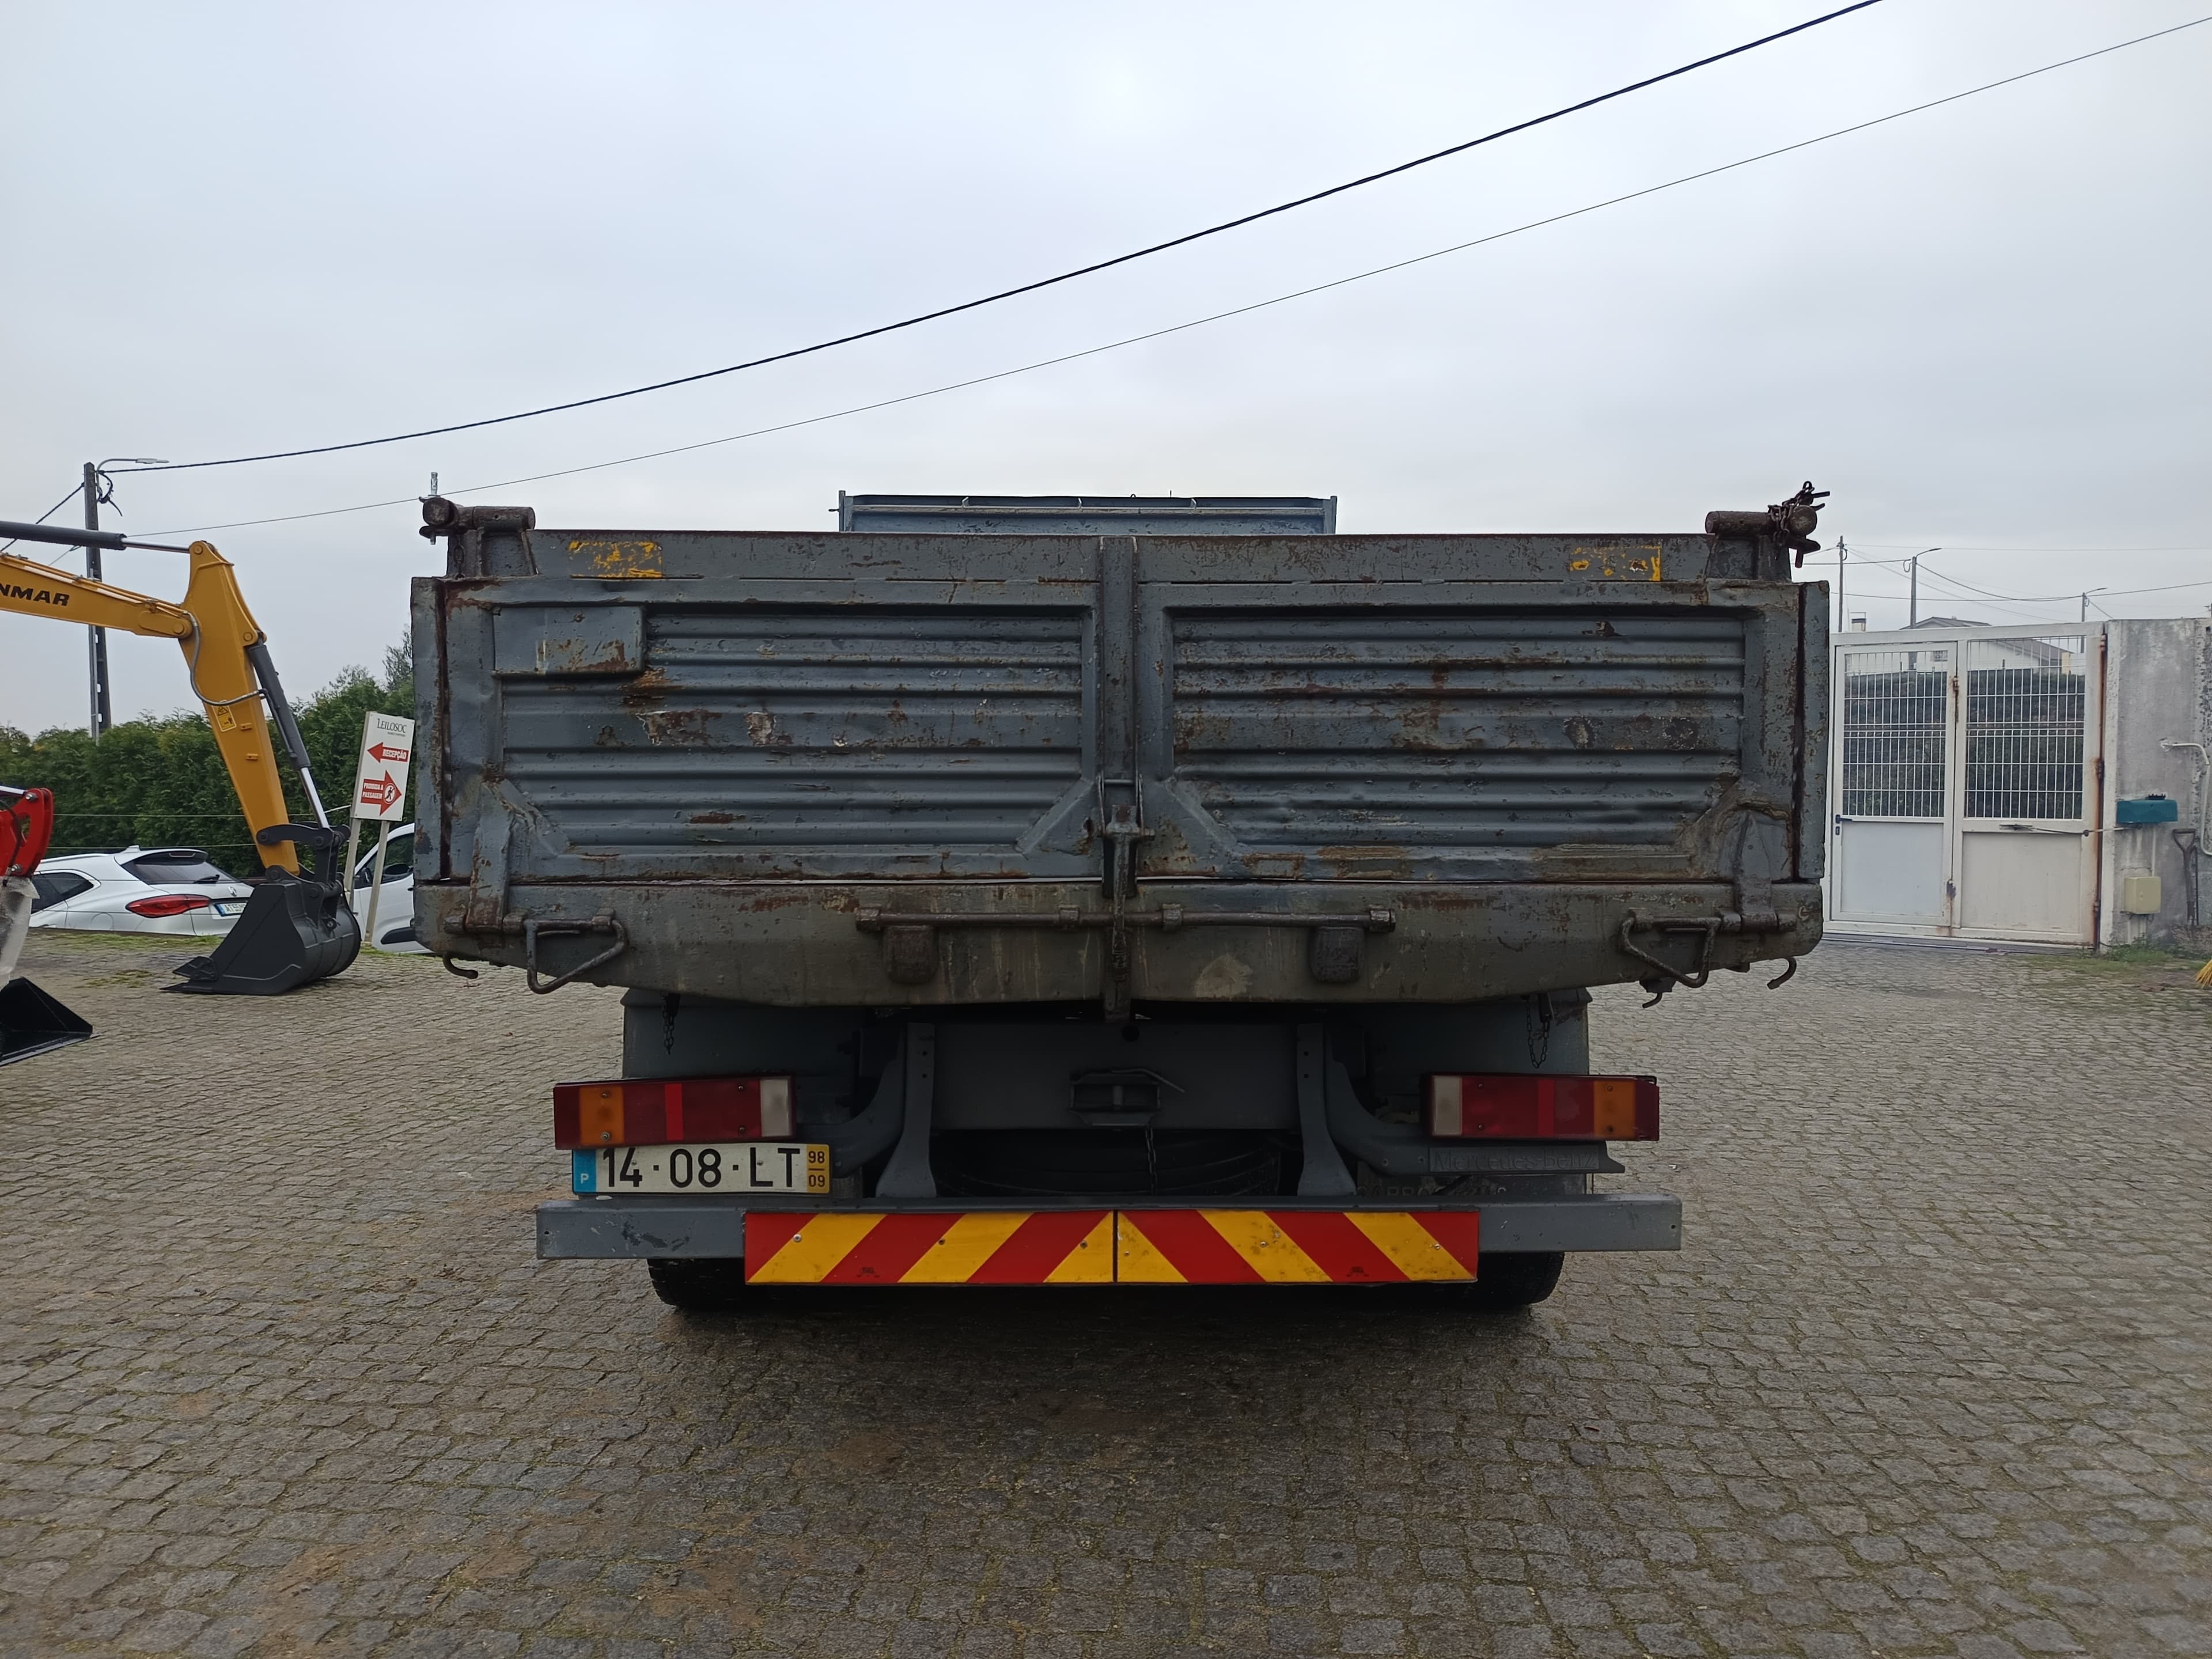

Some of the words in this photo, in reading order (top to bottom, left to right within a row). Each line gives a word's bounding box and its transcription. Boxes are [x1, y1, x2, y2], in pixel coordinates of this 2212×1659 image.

[377, 718, 407, 733] LEILOSOC
[808, 1150, 825, 1164] 98
[1433, 1148, 1596, 1171] Mercedes-Benz
[580, 1173, 589, 1184] P
[808, 1174, 825, 1188] 09
